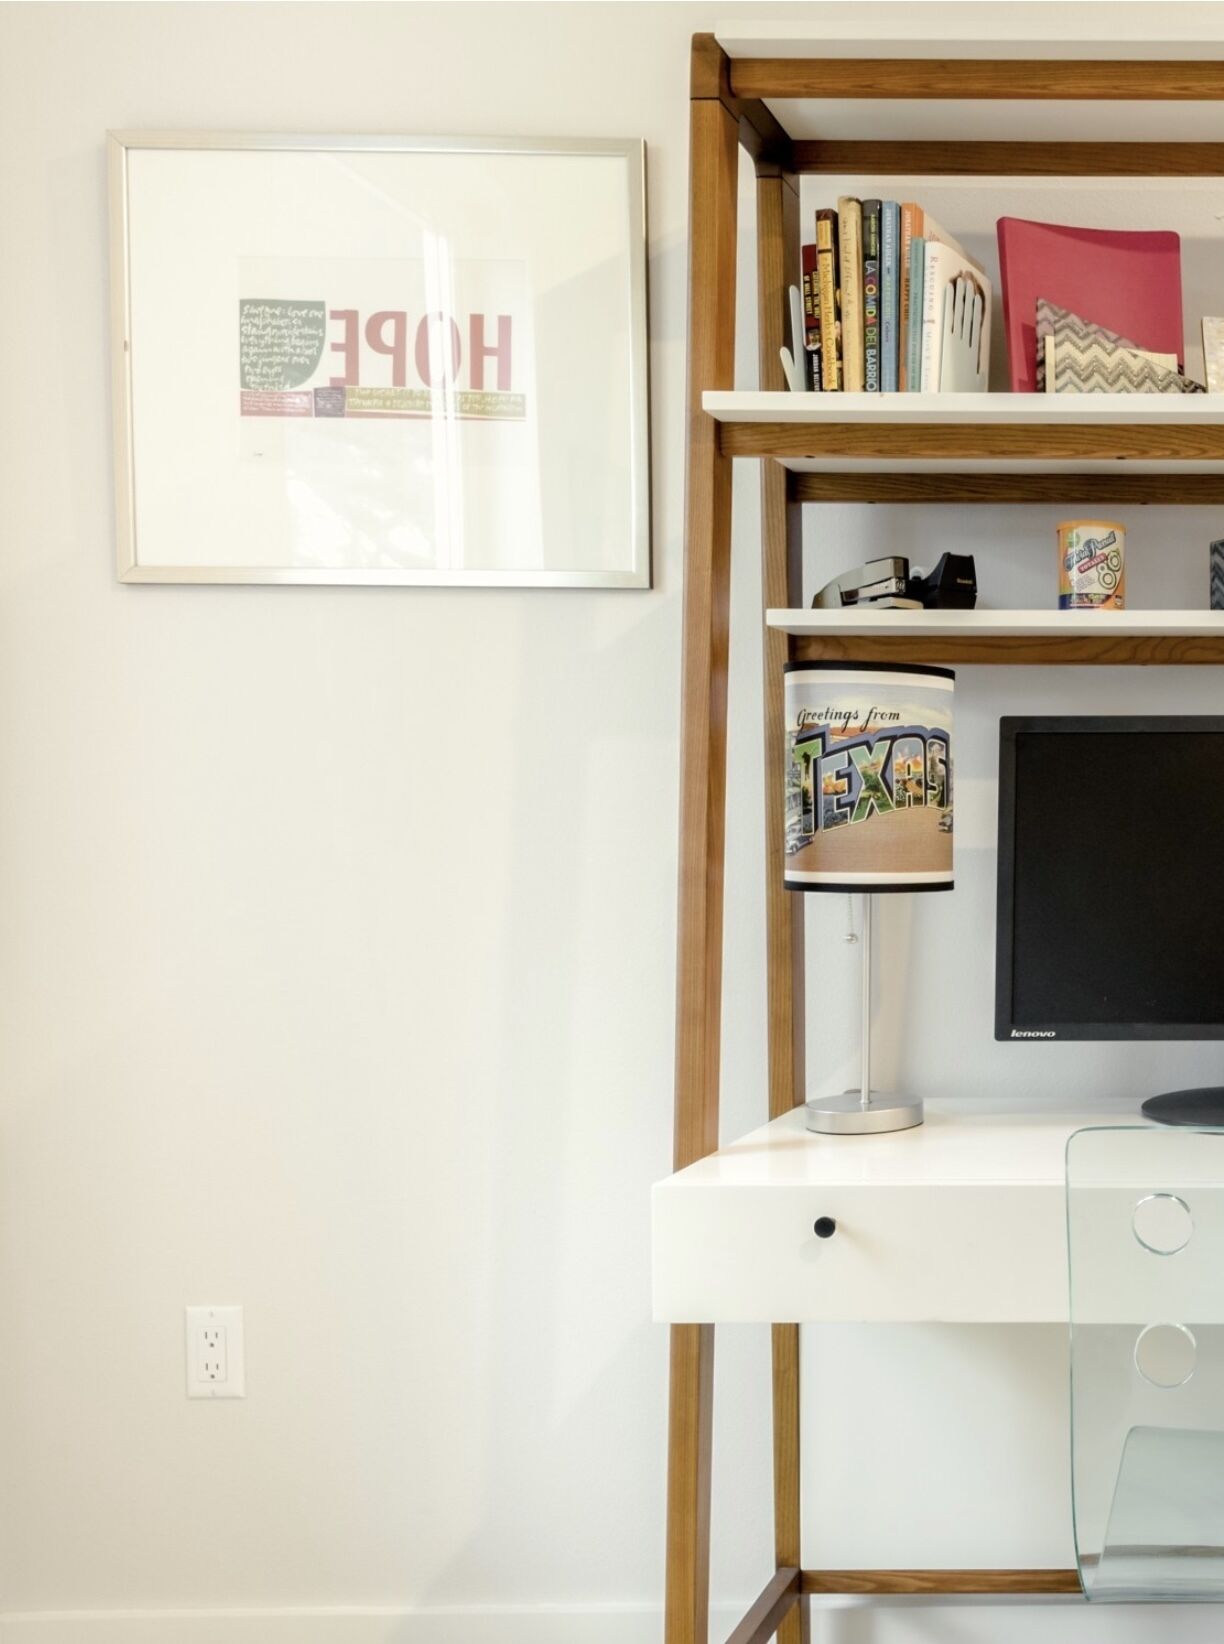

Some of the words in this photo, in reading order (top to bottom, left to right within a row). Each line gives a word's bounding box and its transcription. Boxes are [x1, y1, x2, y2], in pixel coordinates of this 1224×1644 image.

[866, 260, 877, 274] LA
[866, 276, 877, 324] COMIDA
[866, 327, 877, 347] DEL
[826, 336, 835, 385] Cookbook
[866, 349, 877, 391] BARRIO
[797, 706, 859, 732] Greetings
[860, 706, 900, 732] from
[794, 733, 949, 836] TEXAS
[1010, 1029, 1056, 1038] lenovo
